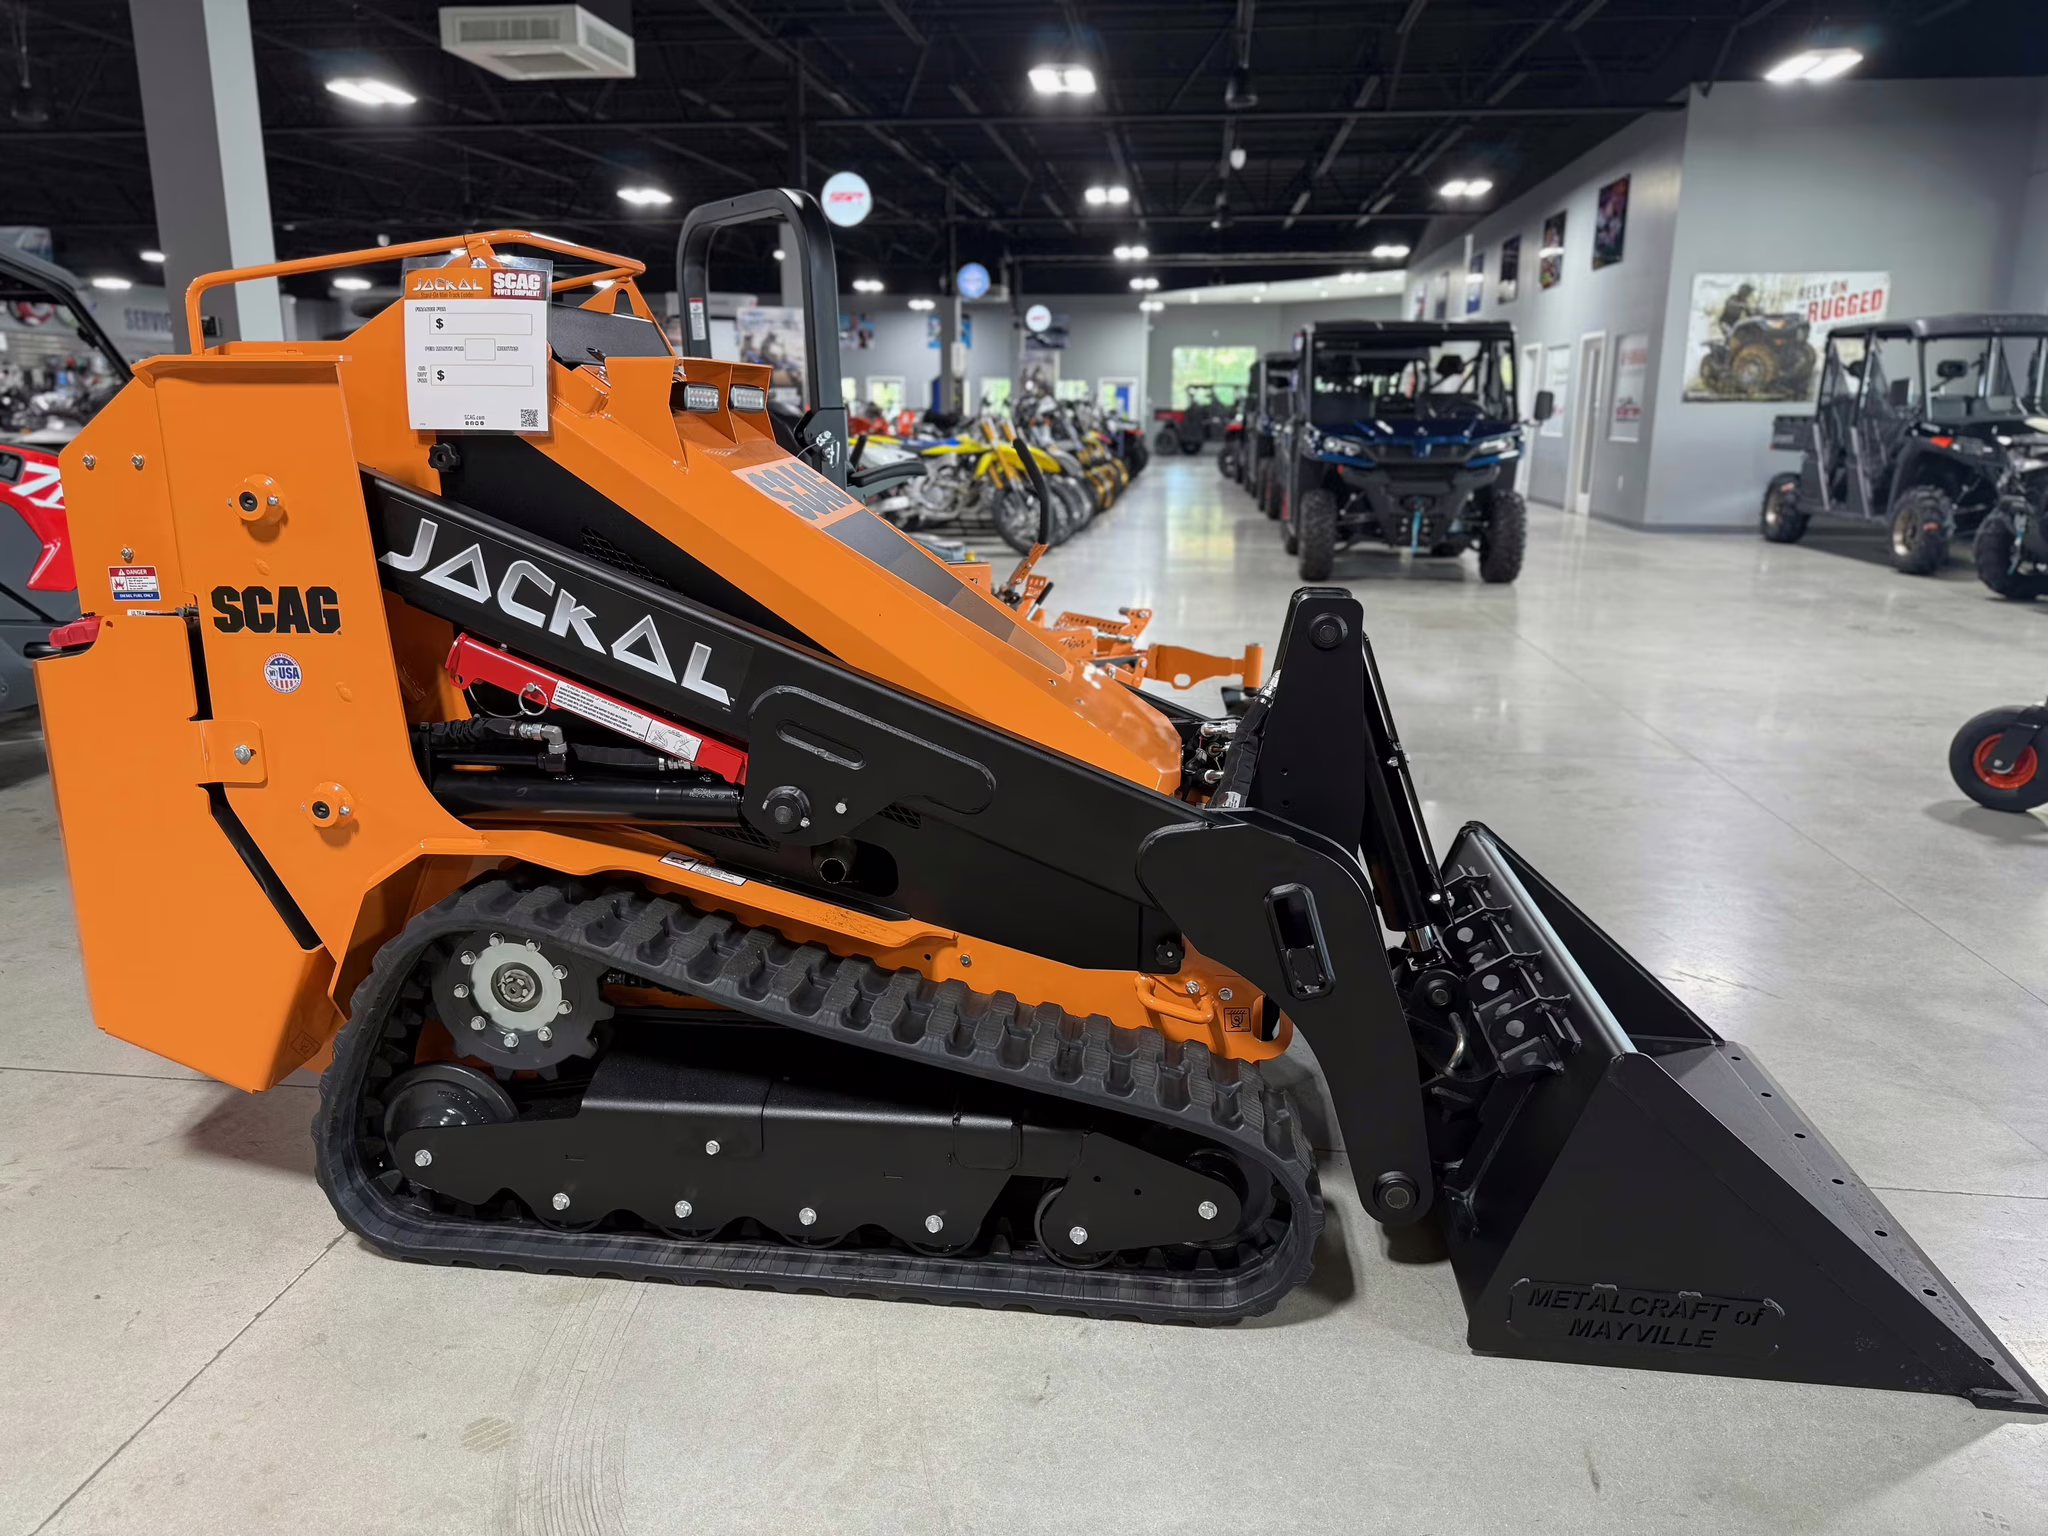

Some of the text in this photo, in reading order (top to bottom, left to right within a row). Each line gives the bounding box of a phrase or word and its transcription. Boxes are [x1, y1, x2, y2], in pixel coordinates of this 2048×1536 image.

[412, 278, 483, 291] JACKAL
[493, 272, 541, 290] SCAG
[493, 288, 541, 298] POWER EQUIPMENT
[1807, 288, 1884, 323] RUGGED
[435, 317, 444, 330] $
[436, 370, 445, 381] $
[746, 462, 854, 521] SCAG
[211, 586, 341, 633] SCAG
[378, 518, 731, 706] JACKAL
[278, 667, 300, 680] USA
[1528, 1288, 1767, 1326] METALCRAFT of
[1568, 1318, 1717, 1348] MAYVILLE
